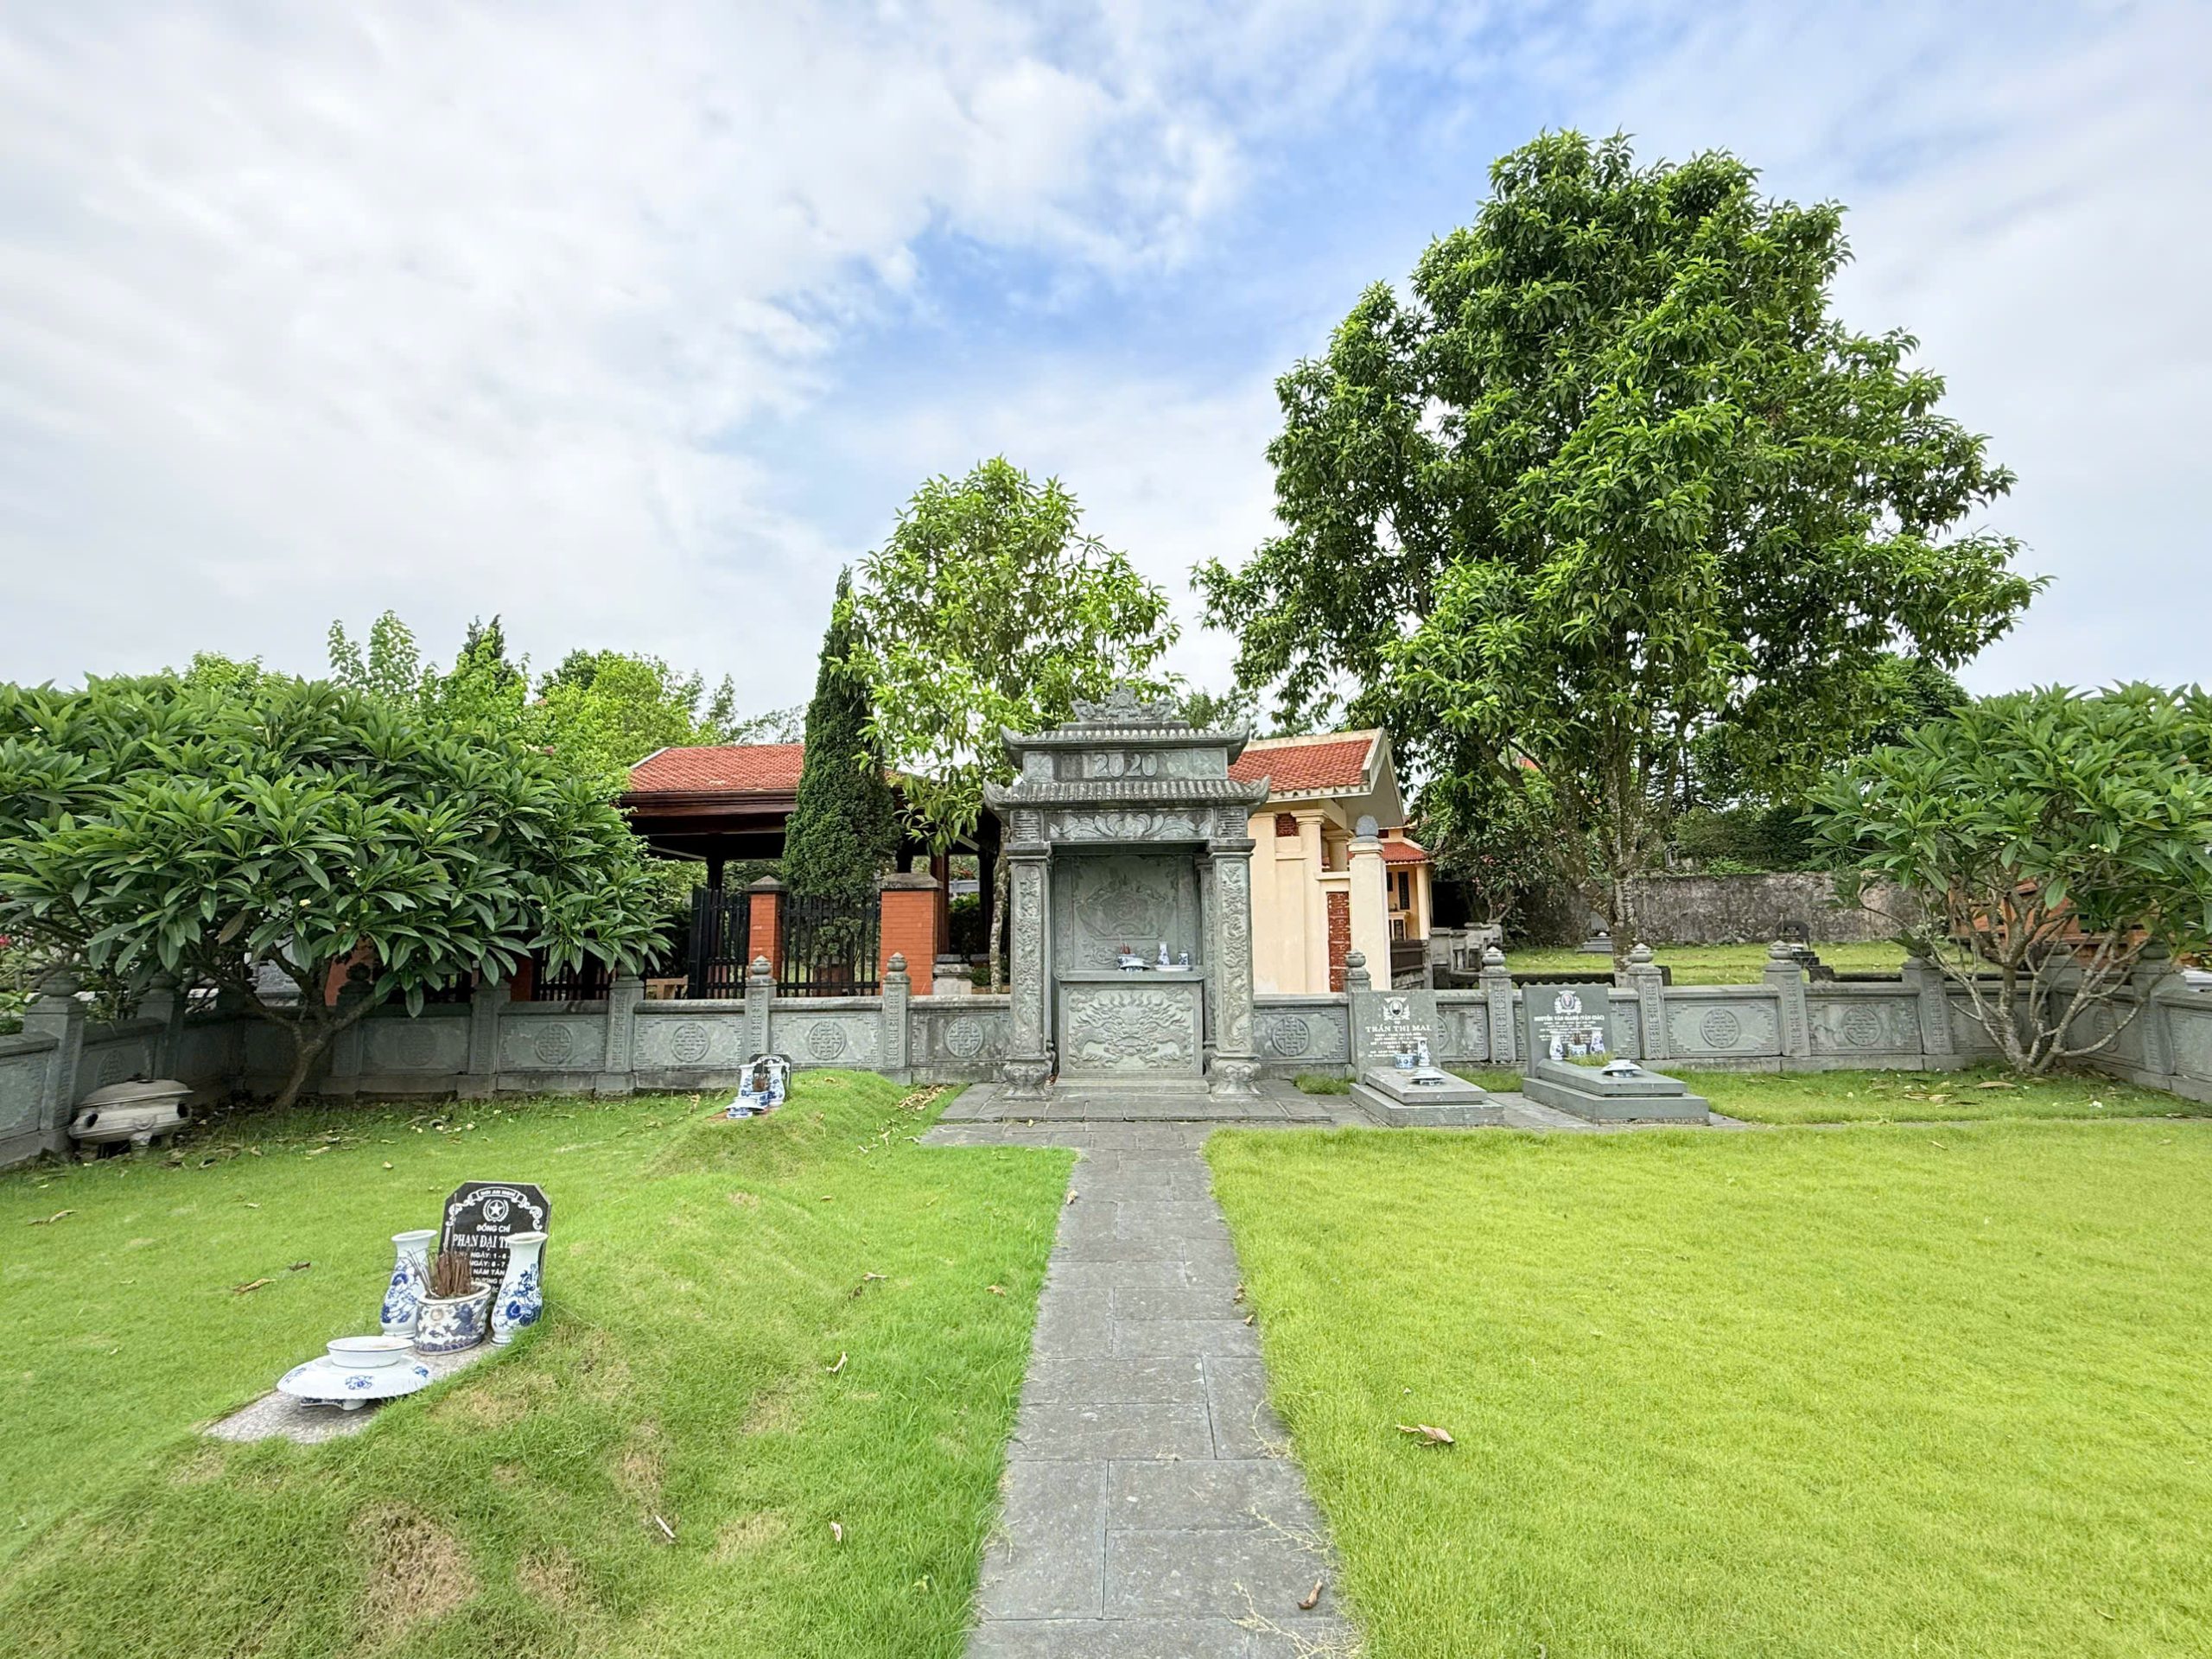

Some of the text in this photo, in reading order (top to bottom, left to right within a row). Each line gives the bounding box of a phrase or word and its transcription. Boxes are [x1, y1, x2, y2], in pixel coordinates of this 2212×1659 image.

[1094, 753, 1158, 778] 2020
[476, 1223, 511, 1233] ĐỒNG CHÍ
[452, 1234, 479, 1247] PHAN
[479, 1235, 498, 1251] ĐẠI
